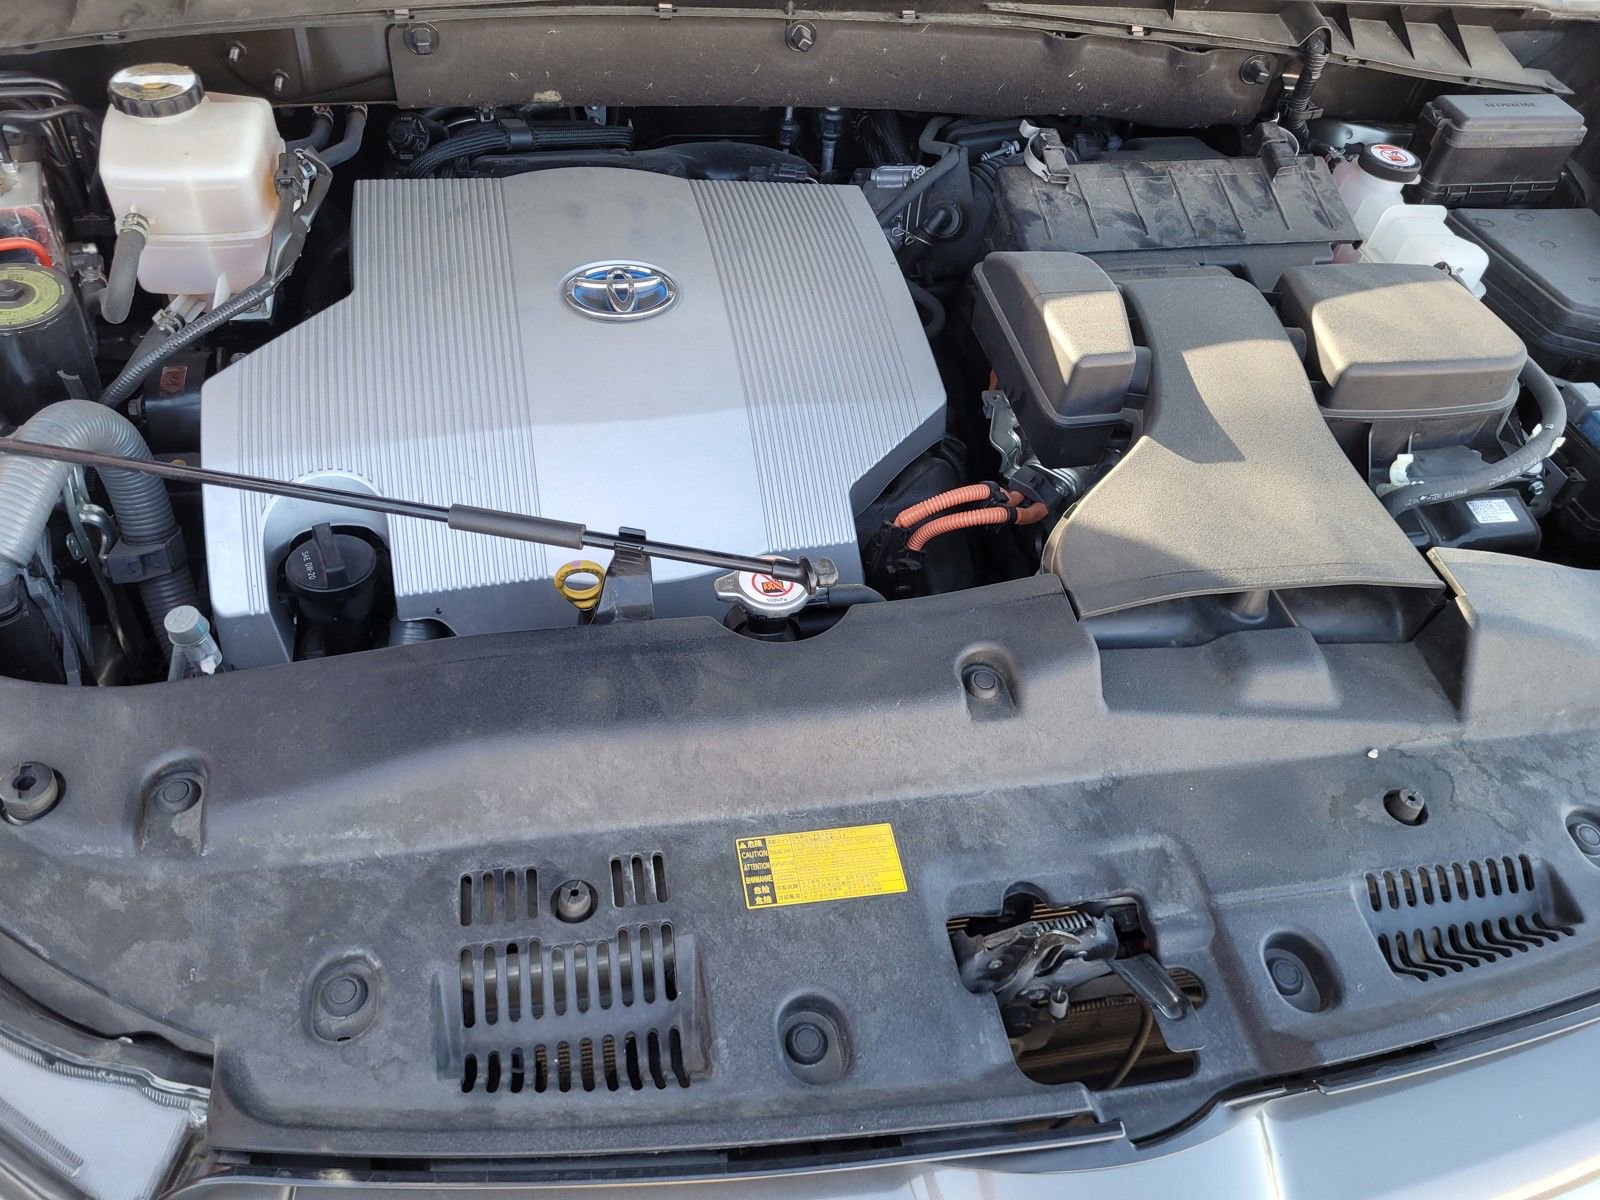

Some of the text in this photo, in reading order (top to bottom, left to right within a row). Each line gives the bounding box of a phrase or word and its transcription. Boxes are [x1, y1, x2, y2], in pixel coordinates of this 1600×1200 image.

[301, 551, 316, 580] SAE 0W-20
[741, 850, 768, 858] CAUTION
[744, 862, 770, 870] ATTENTION
